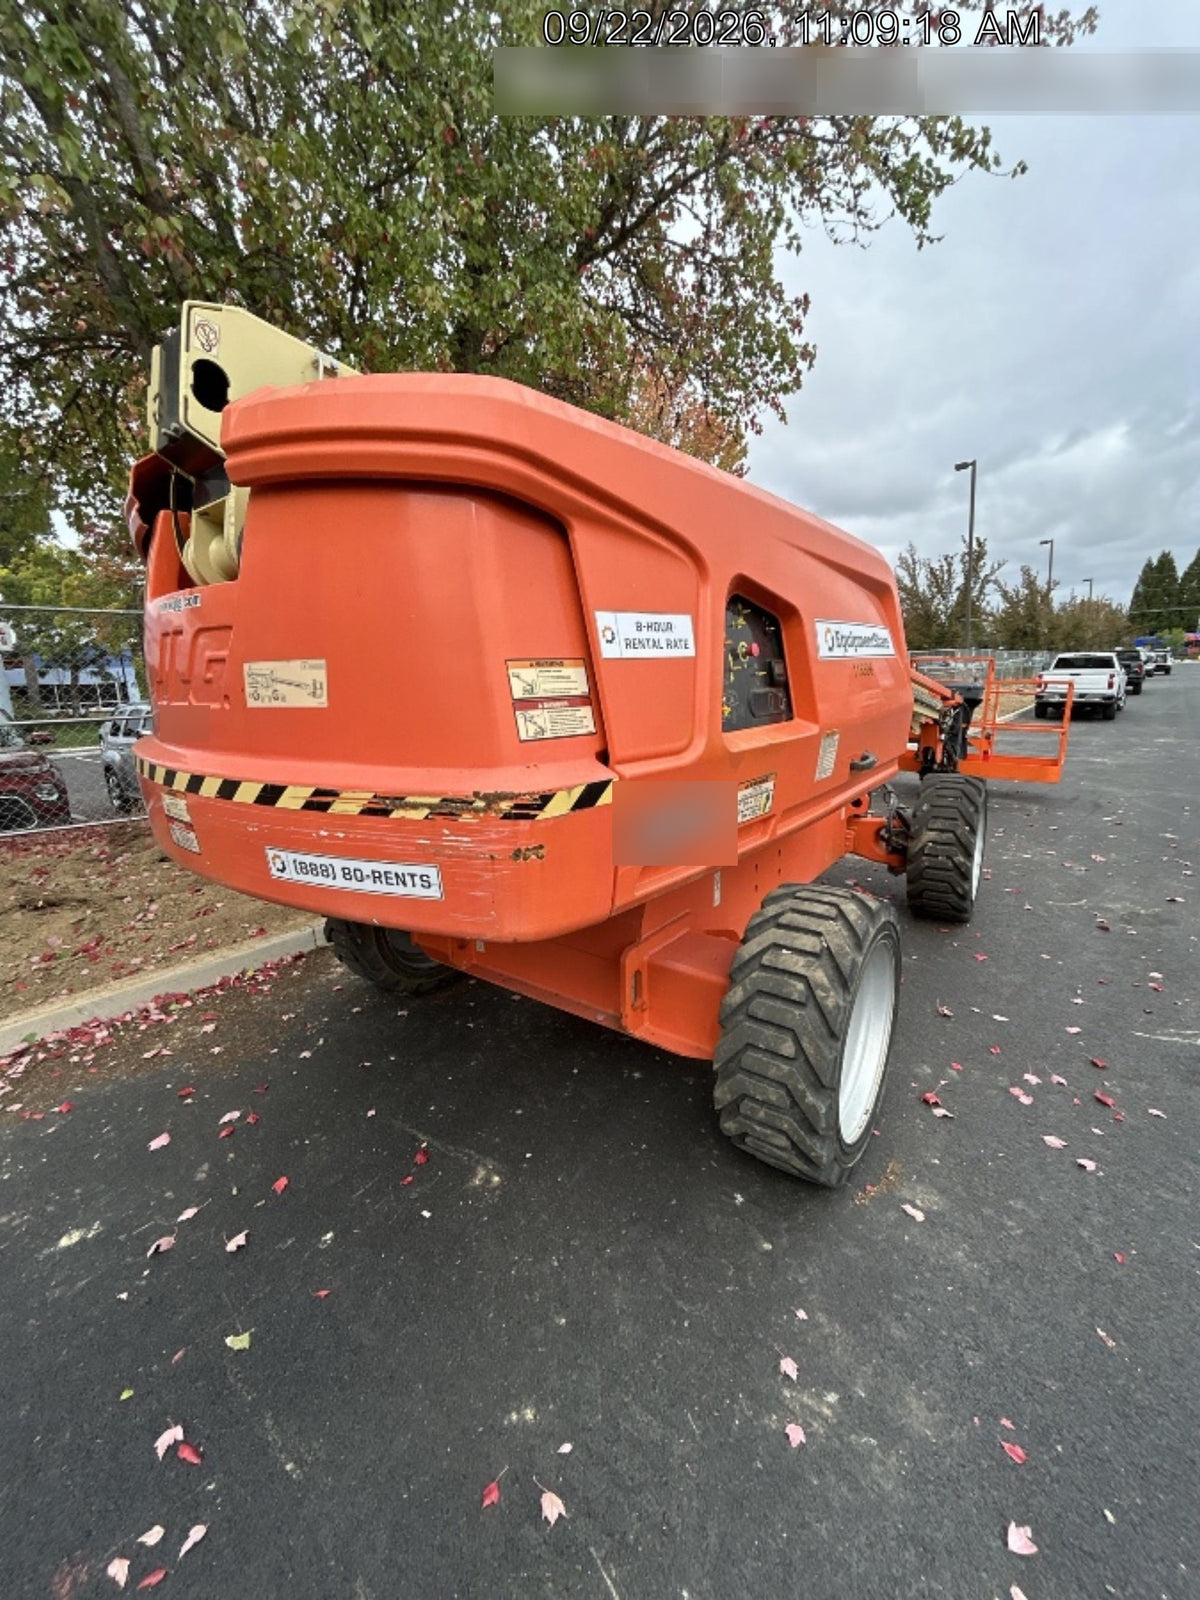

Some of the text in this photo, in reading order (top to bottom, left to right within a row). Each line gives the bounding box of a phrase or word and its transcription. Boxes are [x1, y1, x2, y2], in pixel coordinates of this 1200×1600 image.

[625, 638, 690, 650] RENTAL RATE
[293, 858, 337, 881] (888)
